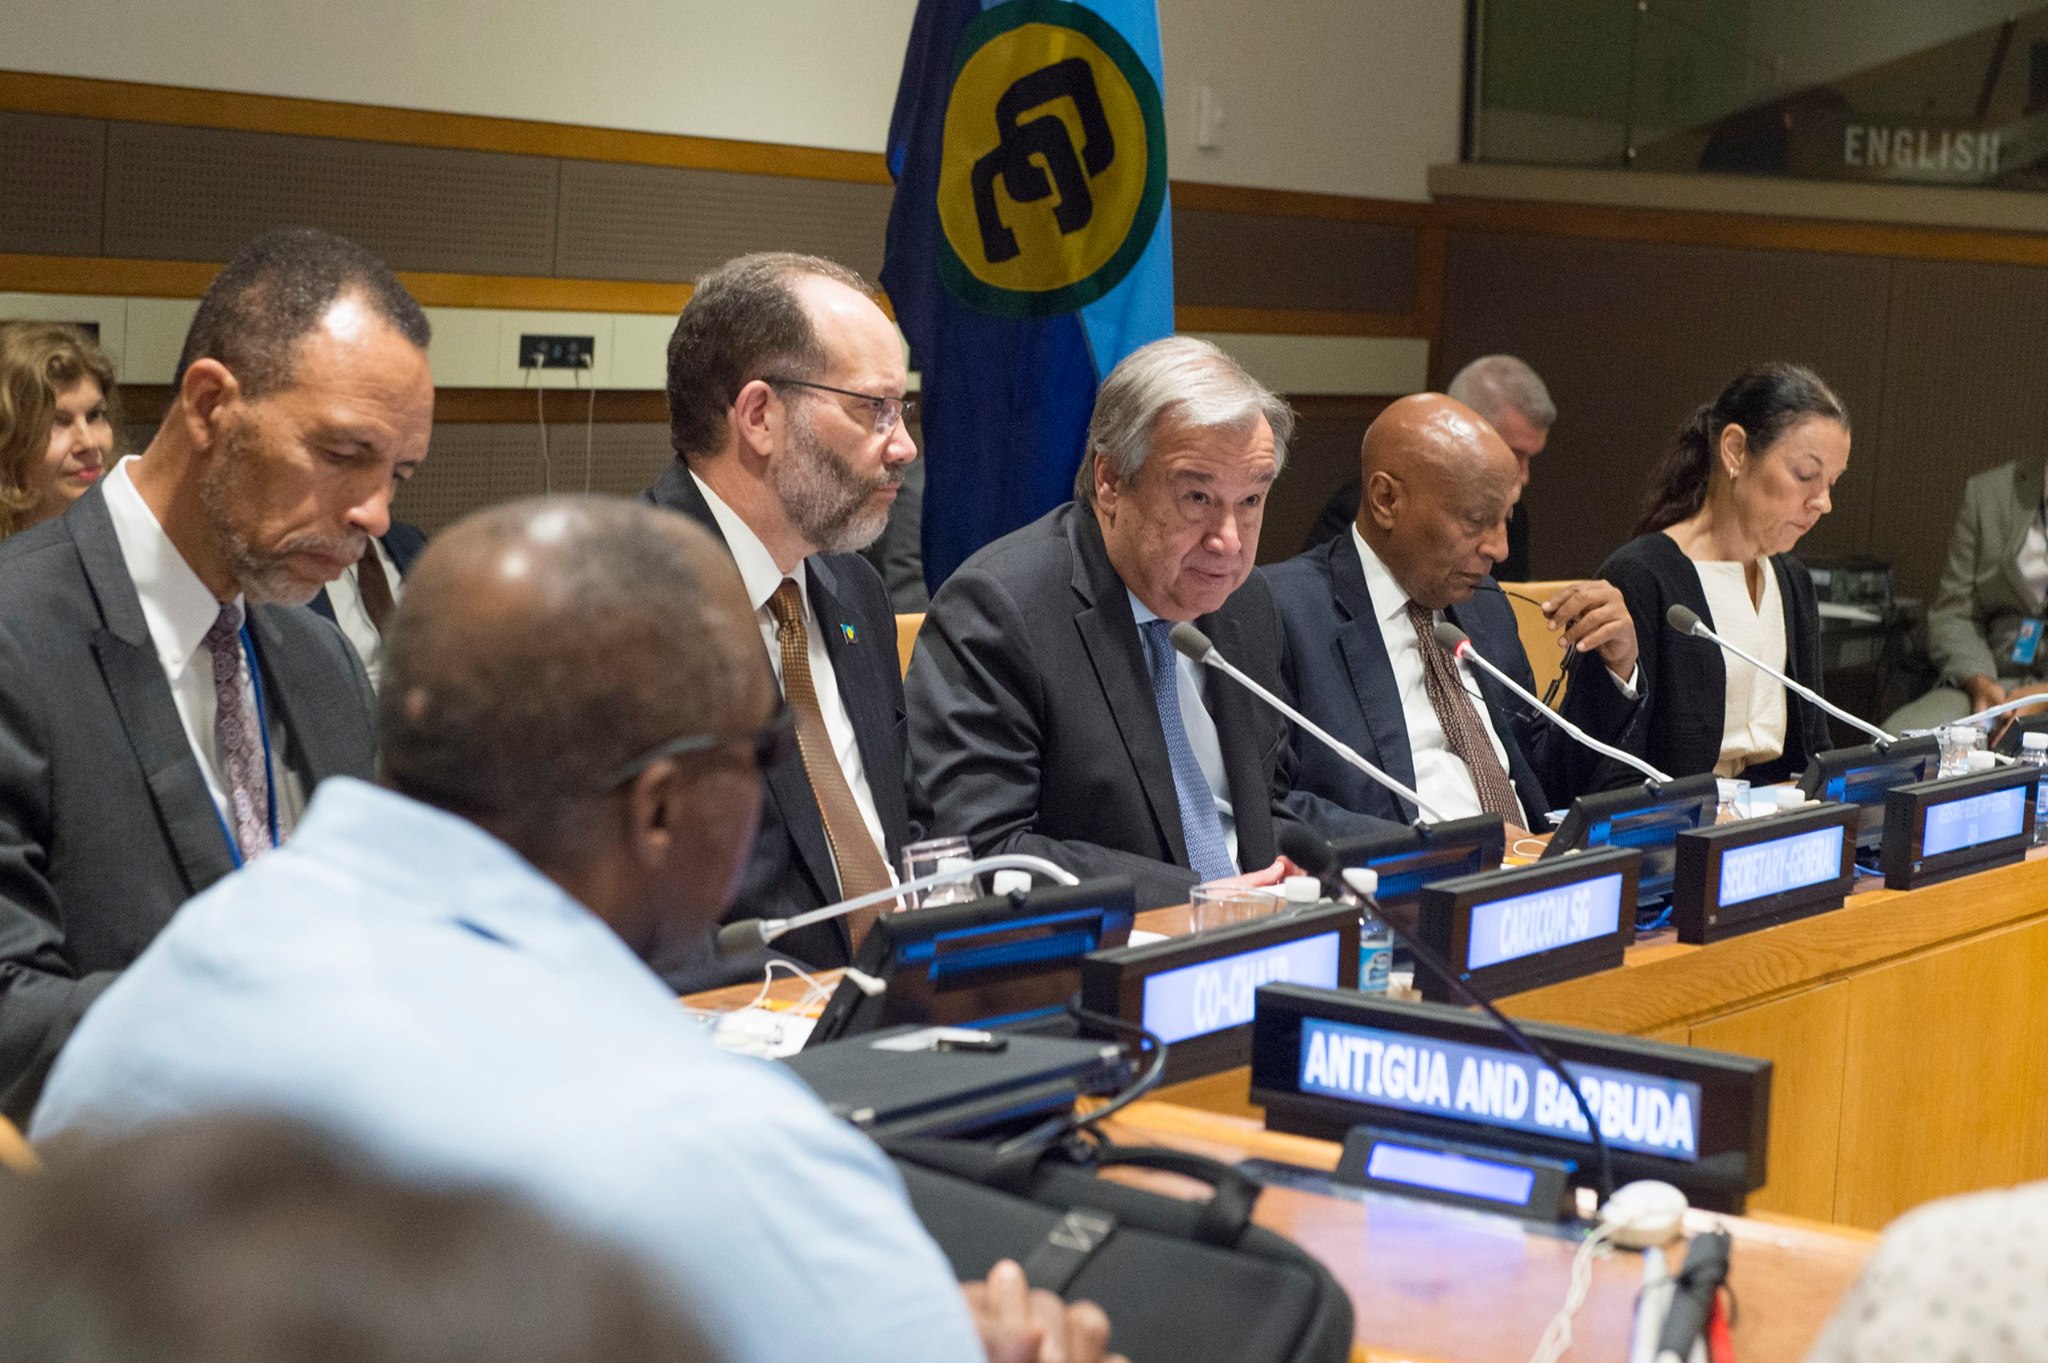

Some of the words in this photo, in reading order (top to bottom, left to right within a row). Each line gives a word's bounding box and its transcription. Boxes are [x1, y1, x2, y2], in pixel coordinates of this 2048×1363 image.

[1845, 126, 2001, 173] ENGLISH
[1502, 894, 1568, 956] CARICOM
[1569, 888, 1591, 938] SG
[1304, 1031, 1451, 1109] ANTIGUA
[1455, 1056, 1530, 1122] AND
